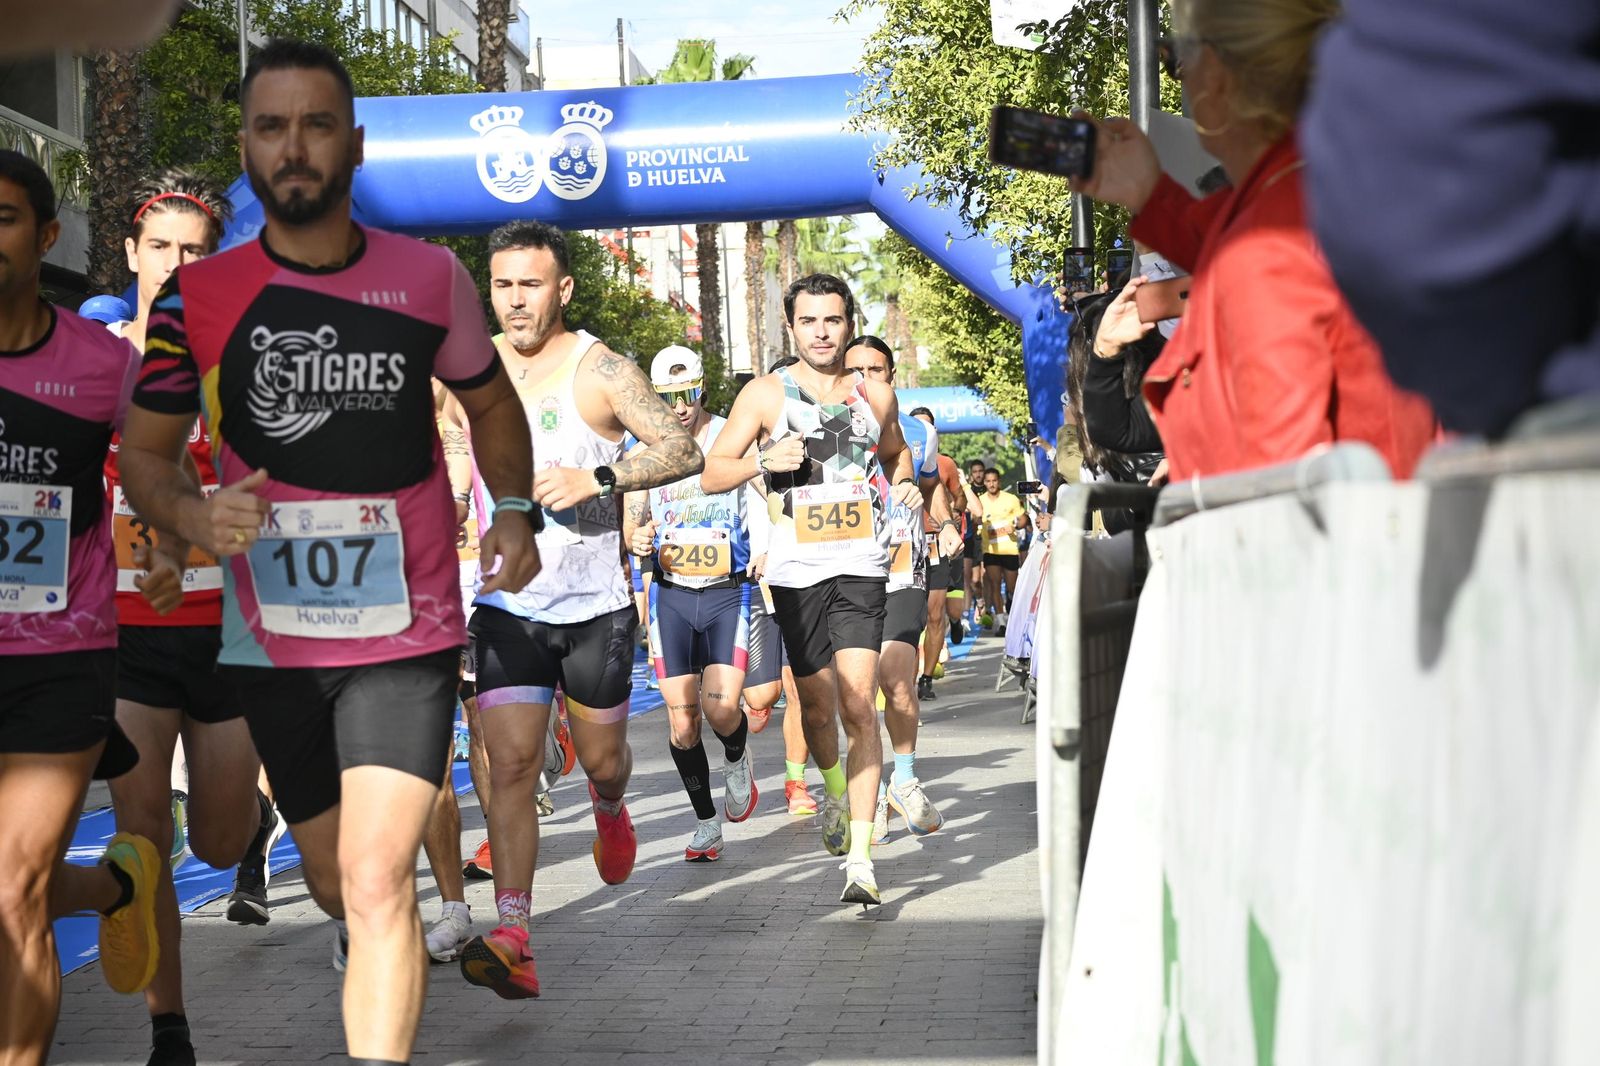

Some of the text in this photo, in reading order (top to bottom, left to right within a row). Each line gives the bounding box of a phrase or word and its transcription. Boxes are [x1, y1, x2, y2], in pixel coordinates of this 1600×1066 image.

[626, 145, 750, 168] PROVINCIAL
[647, 167, 726, 187] HUELVA
[361, 291, 408, 305] GOBIK
[291, 352, 406, 393] TIGRES
[295, 393, 398, 411] VALVERDE
[0, 441, 58, 475] GRES
[807, 502, 861, 531] 545
[129, 517, 153, 549] 3
[273, 538, 376, 588] 107
[670, 544, 719, 568] 249
[889, 543, 903, 564] 7
